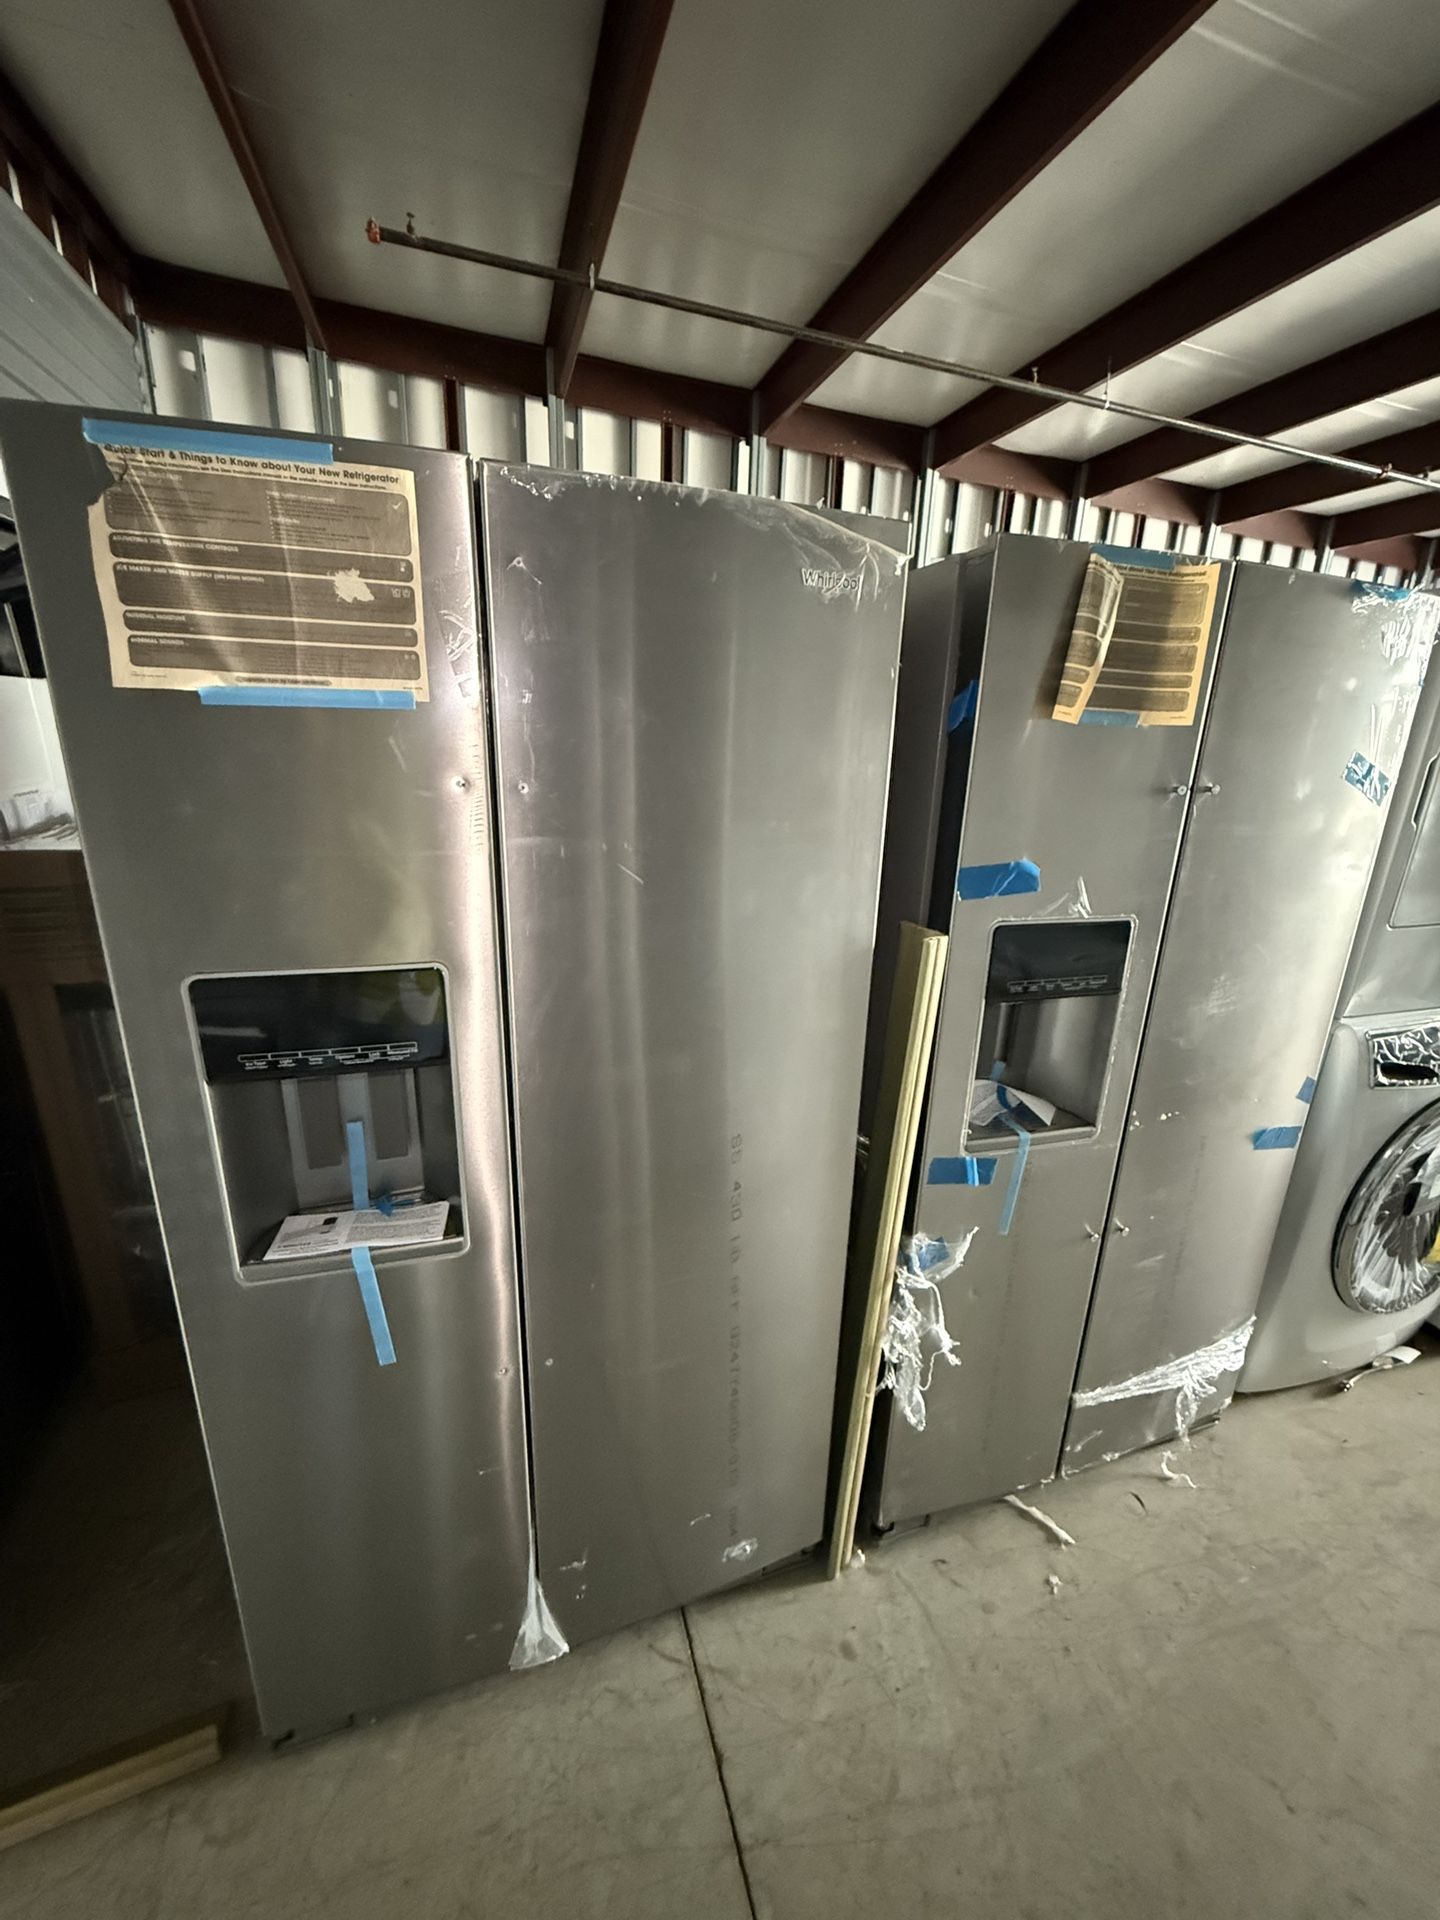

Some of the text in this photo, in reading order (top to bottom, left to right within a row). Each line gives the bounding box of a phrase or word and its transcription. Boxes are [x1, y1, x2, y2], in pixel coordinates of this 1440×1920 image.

[104, 443, 400, 485] Quick Start & Things to Know about Your New Refrigerator
